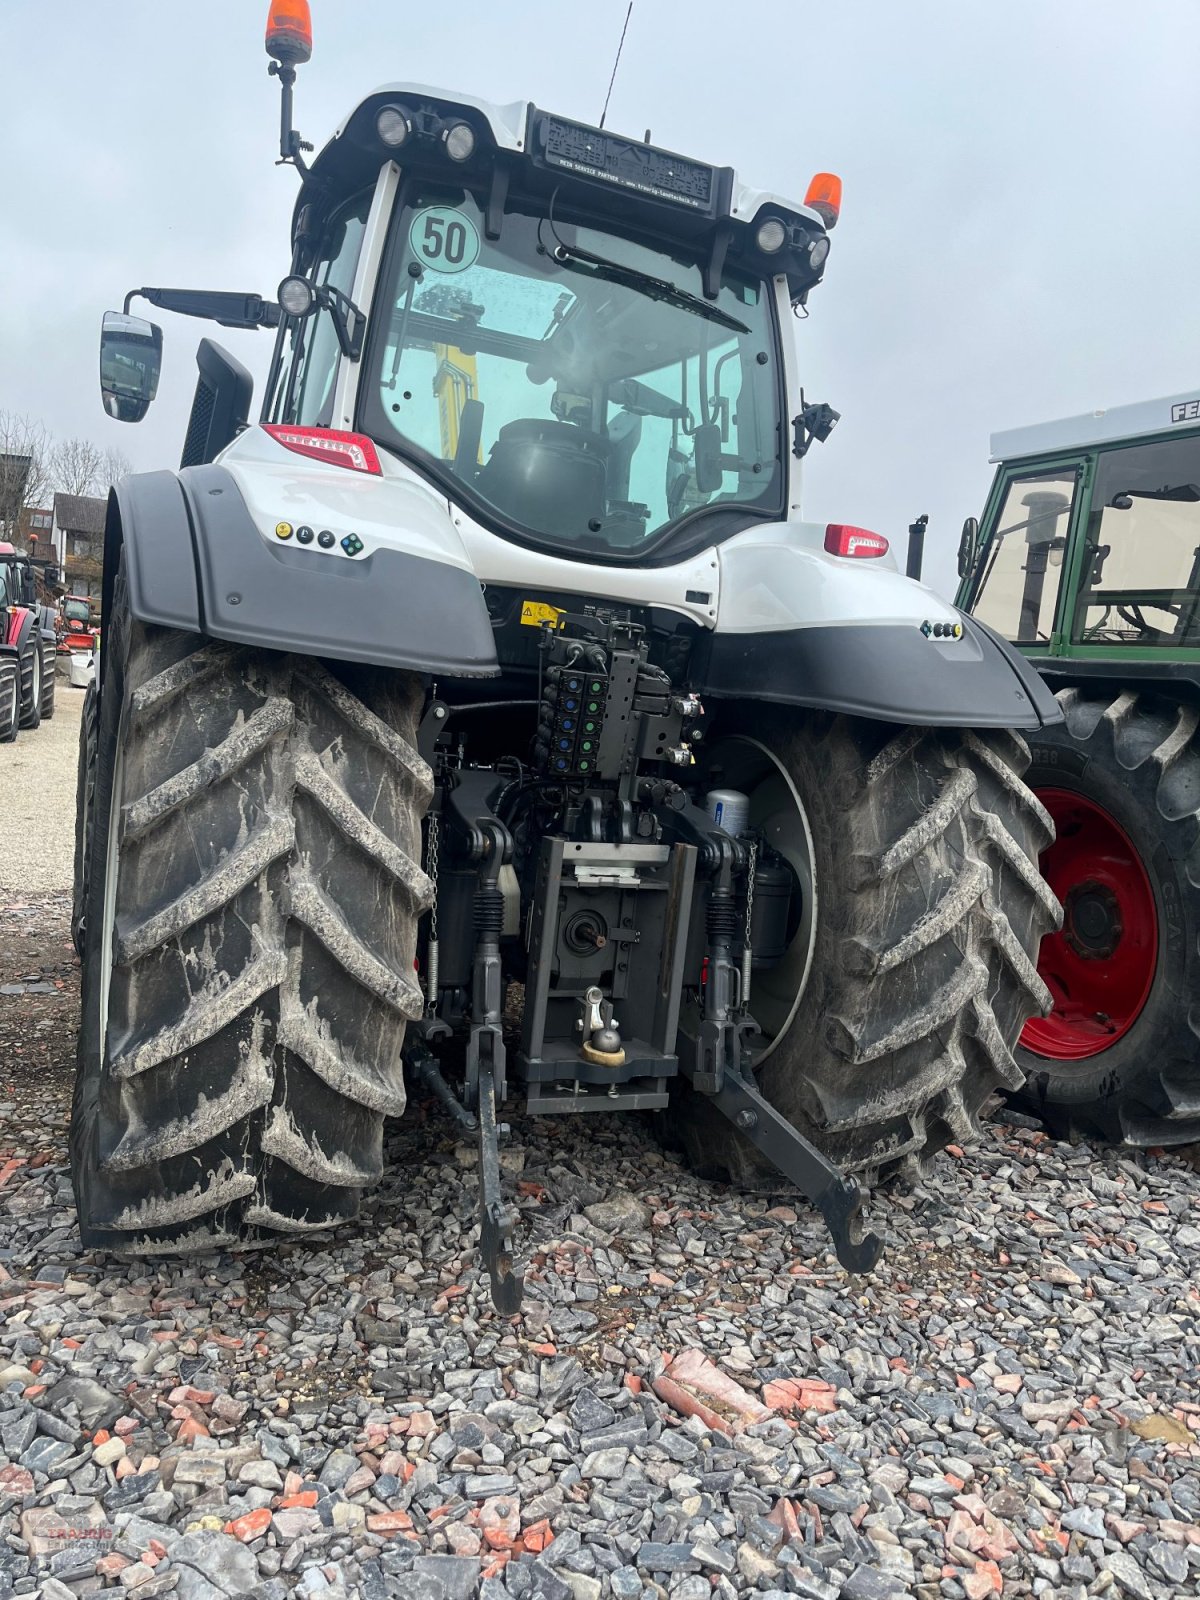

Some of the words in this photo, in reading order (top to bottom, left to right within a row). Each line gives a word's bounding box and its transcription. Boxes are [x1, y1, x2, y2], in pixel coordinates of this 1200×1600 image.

[559, 159, 573, 169] MEIN
[574, 163, 596, 176] SERVICE
[597, 170, 619, 183] PARTNER
[626, 181, 698, 206] www.traurig-landtechnik.de
[422, 216, 466, 264] 50
[1171, 400, 1200, 422] FE
